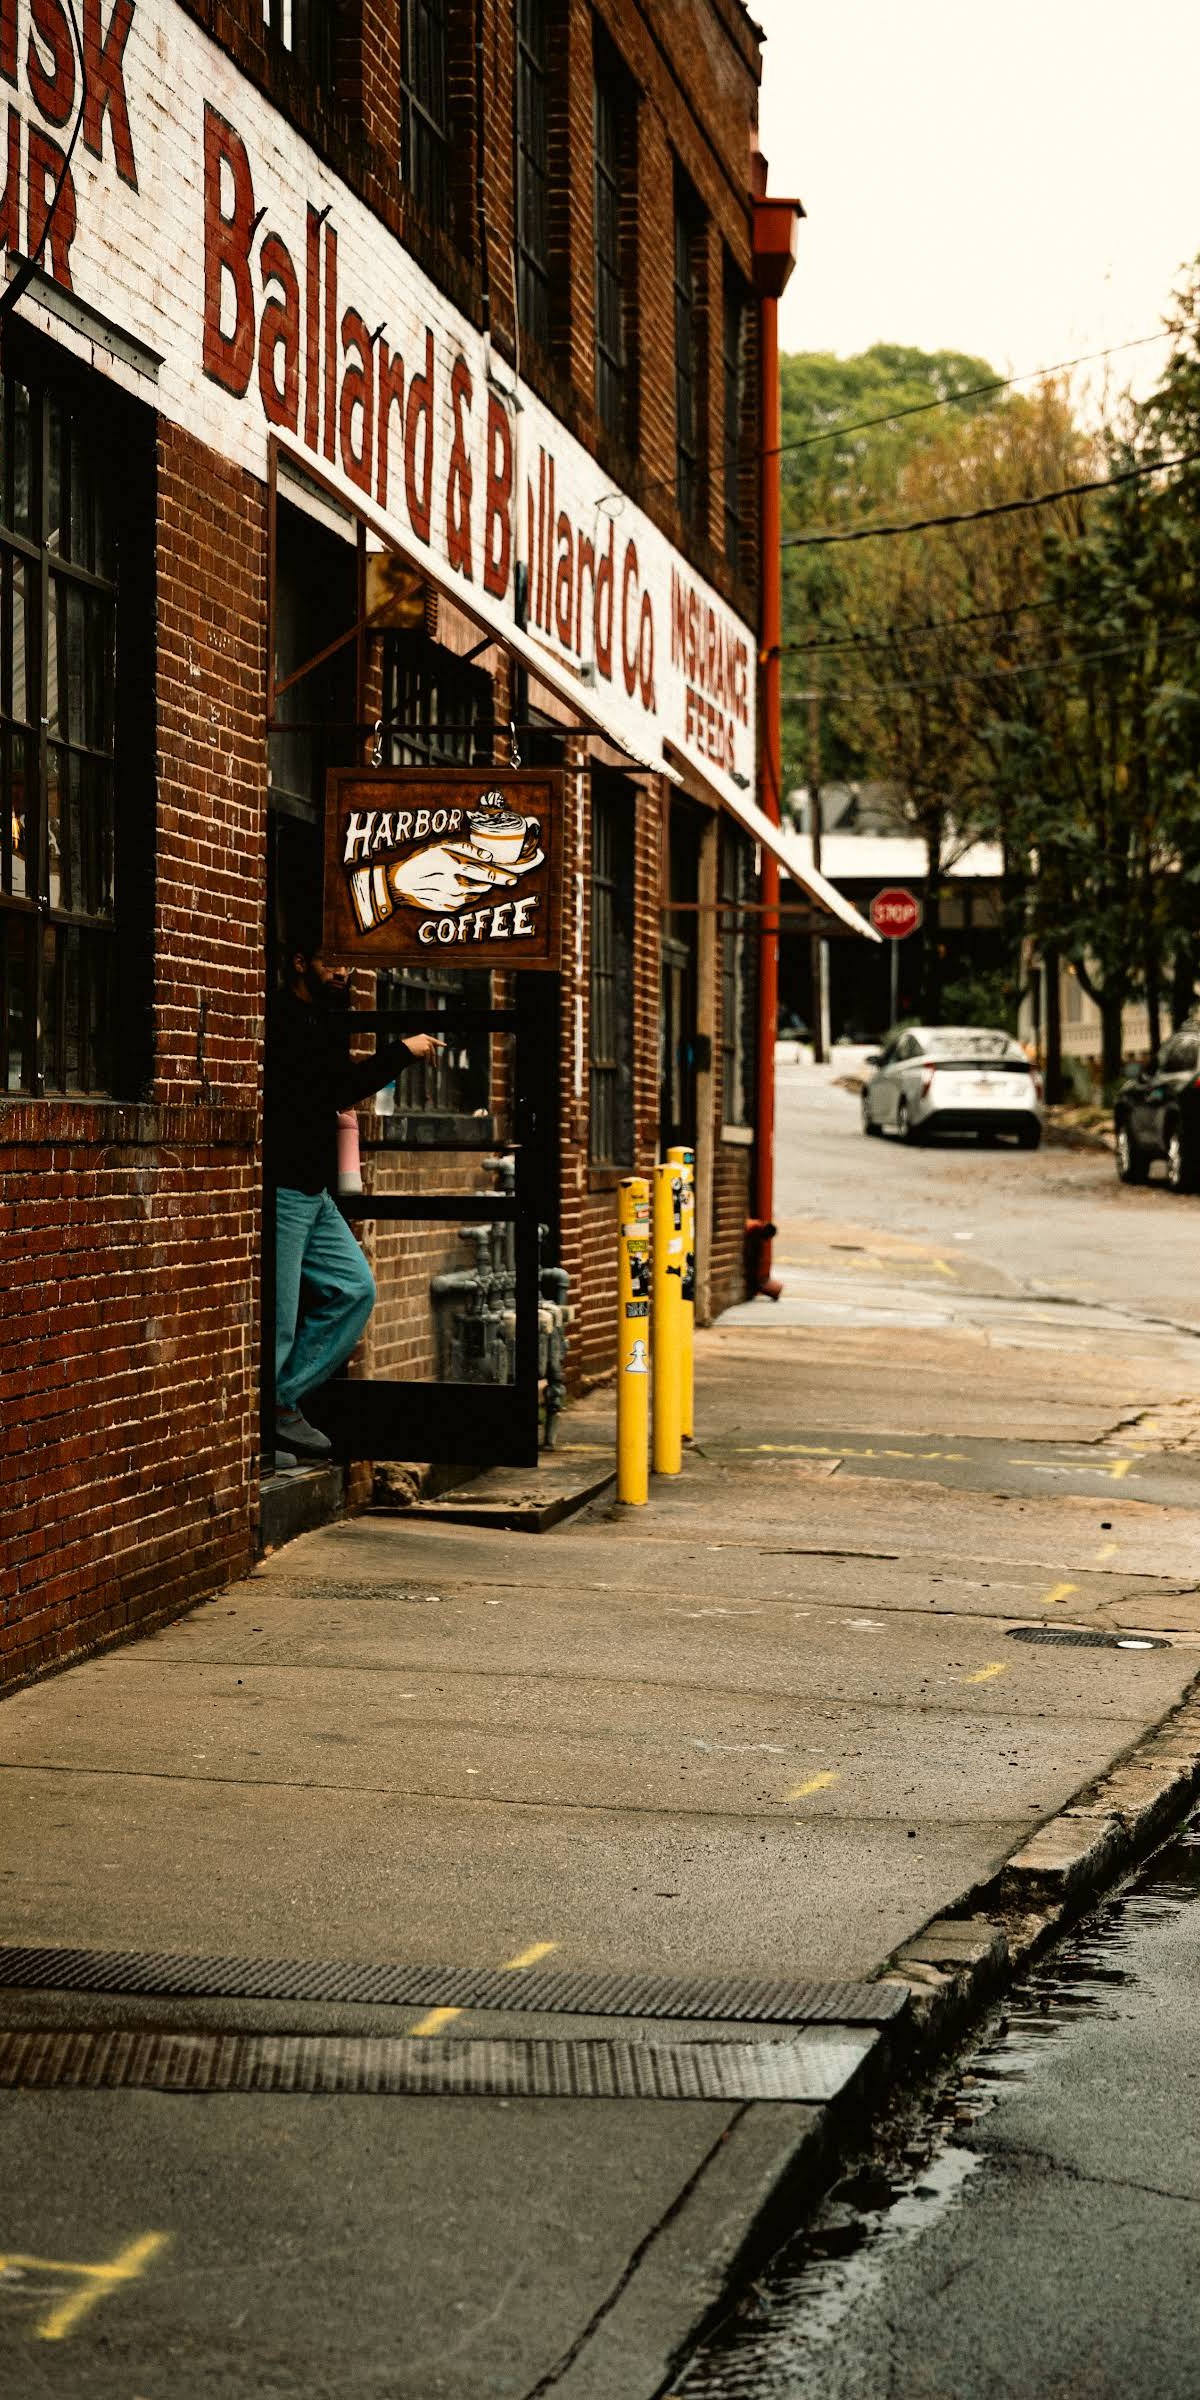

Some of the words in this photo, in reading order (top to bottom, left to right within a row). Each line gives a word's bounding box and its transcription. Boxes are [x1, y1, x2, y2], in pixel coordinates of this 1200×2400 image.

[202, 98, 436, 548] Ballard
[446, 353, 473, 583] &
[671, 561, 748, 728] INSURANCE
[686, 684, 736, 774] FEEDS
[343, 808, 463, 865] HARBOR
[417, 895, 538, 943] COFFEE
[873, 903, 915, 924] STOP
